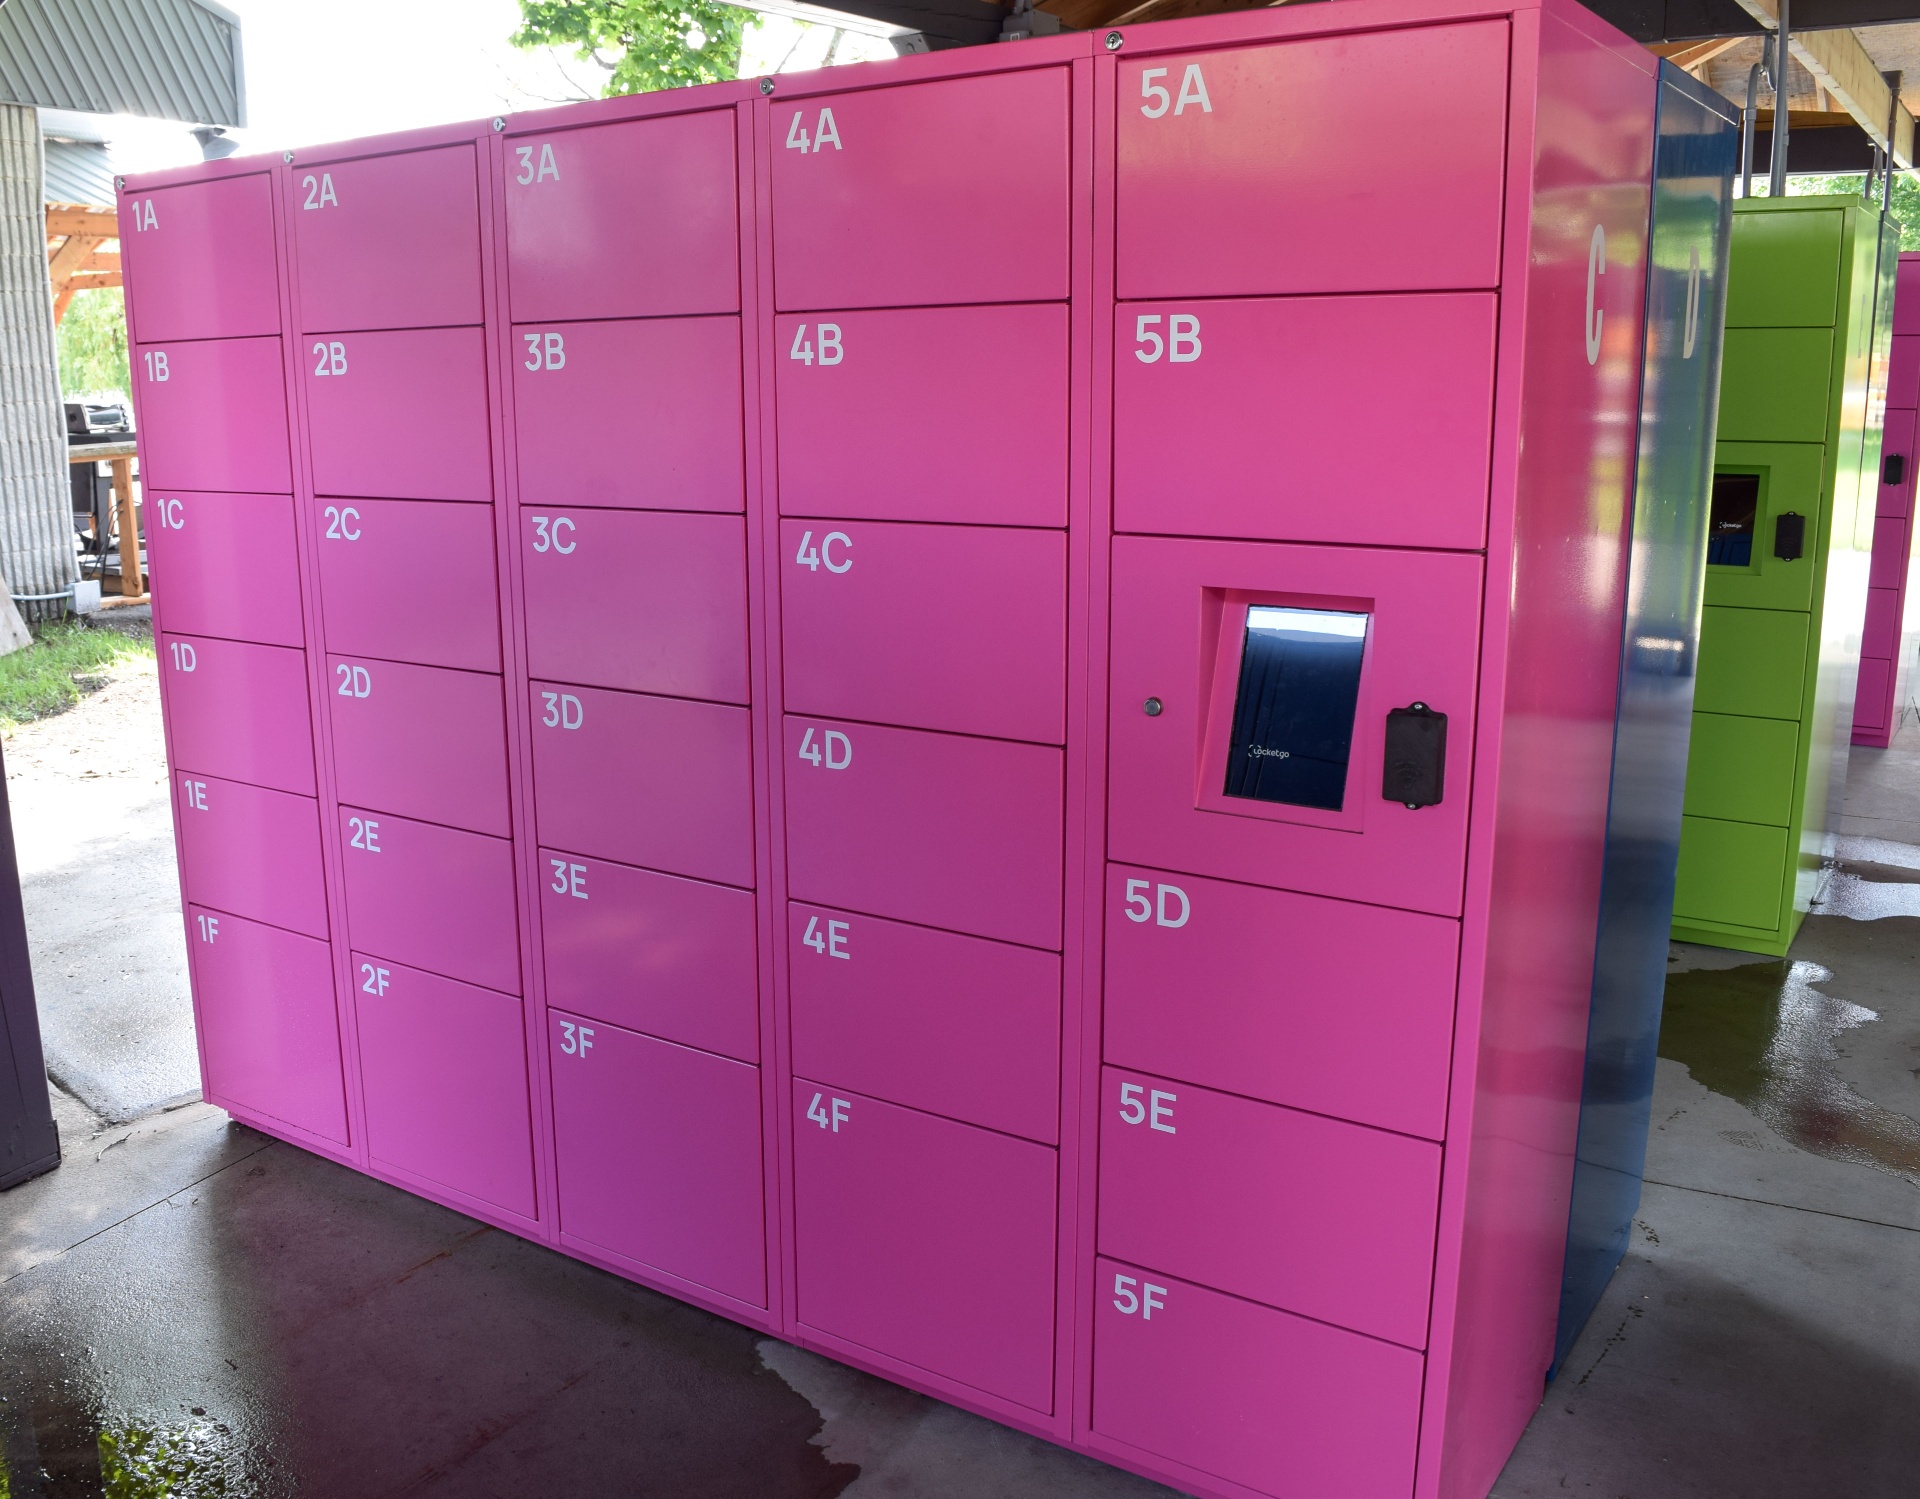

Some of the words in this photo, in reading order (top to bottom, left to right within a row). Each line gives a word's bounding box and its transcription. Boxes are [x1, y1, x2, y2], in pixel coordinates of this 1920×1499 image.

[1141, 64, 1212, 118] 5A
[786, 108, 842, 153] 4A
[516, 144, 560, 185] 3A
[303, 173, 337, 210] 2A
[132, 199, 158, 231] 1A
[1586, 224, 1606, 366] C
[1683, 245, 1700, 359] D
[524, 333, 565, 371] 3B
[791, 324, 843, 365] 4B
[1135, 314, 1201, 363] 5B
[145, 352, 169, 381] 1B
[313, 342, 347, 376] 2B
[158, 499, 184, 529] 1C
[325, 506, 360, 540] 2C
[532, 517, 576, 554] 3C
[797, 531, 852, 573] 4C
[171, 643, 196, 672] 1D
[337, 664, 370, 698] 2D
[542, 692, 583, 729] 3D
[799, 728, 852, 769] 4D
[185, 780, 208, 810] 1E
[349, 817, 380, 852] 2E
[551, 859, 588, 899] 3E
[1125, 879, 1190, 928] 5D
[198, 915, 218, 943] 1F
[803, 916, 850, 959] 4E
[361, 964, 389, 996] 2F
[560, 1021, 594, 1058] 3F
[807, 1093, 850, 1132] 4F
[1120, 1083, 1176, 1134] 5E
[1114, 1274, 1167, 1320] 5F
